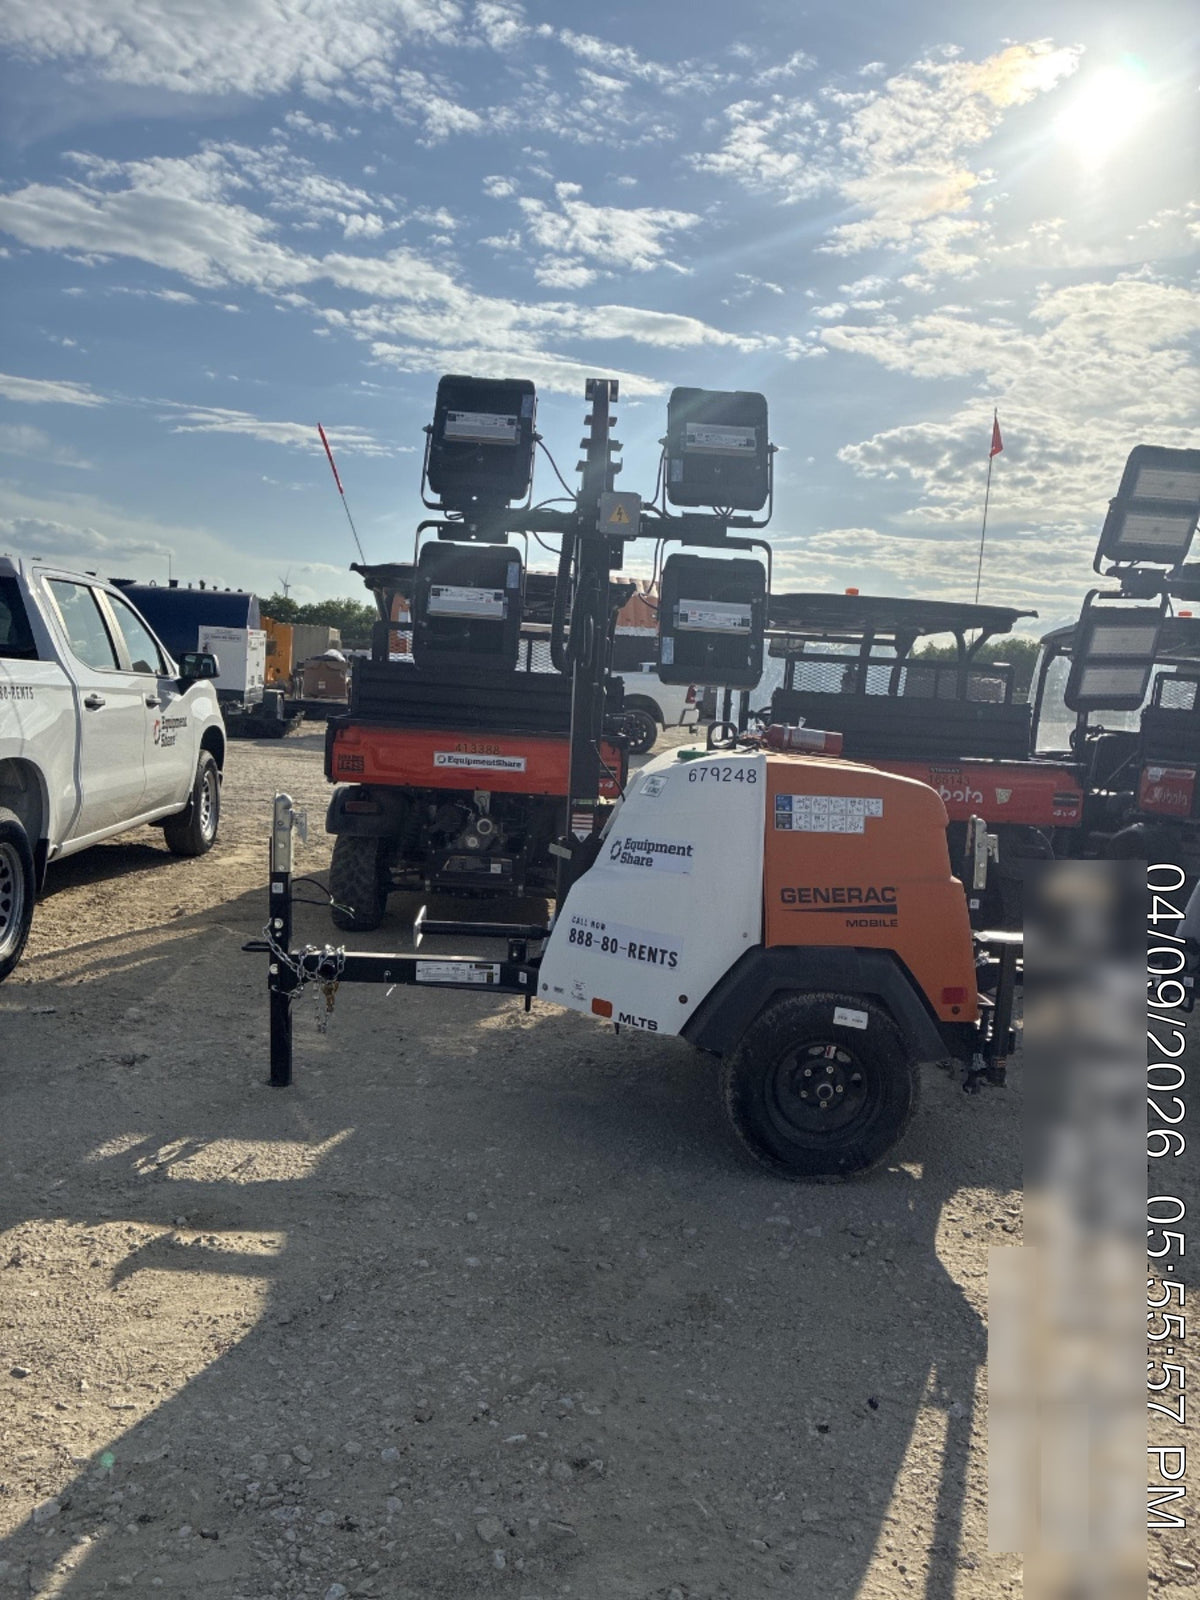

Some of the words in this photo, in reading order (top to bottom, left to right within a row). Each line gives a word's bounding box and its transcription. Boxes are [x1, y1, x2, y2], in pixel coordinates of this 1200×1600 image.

[447, 755, 522, 768] EquipmentShare
[688, 767, 757, 783] 679248
[940, 785, 984, 803] bota
[624, 837, 694, 857] Equipment
[620, 851, 654, 867] Share
[780, 886, 897, 904] GENERAC
[571, 915, 588, 927] CALL
[591, 920, 606, 931] NOW
[845, 919, 899, 928] MOBILE
[568, 927, 678, 968] 888-80-RENTS
[619, 1012, 658, 1031] MLTS
